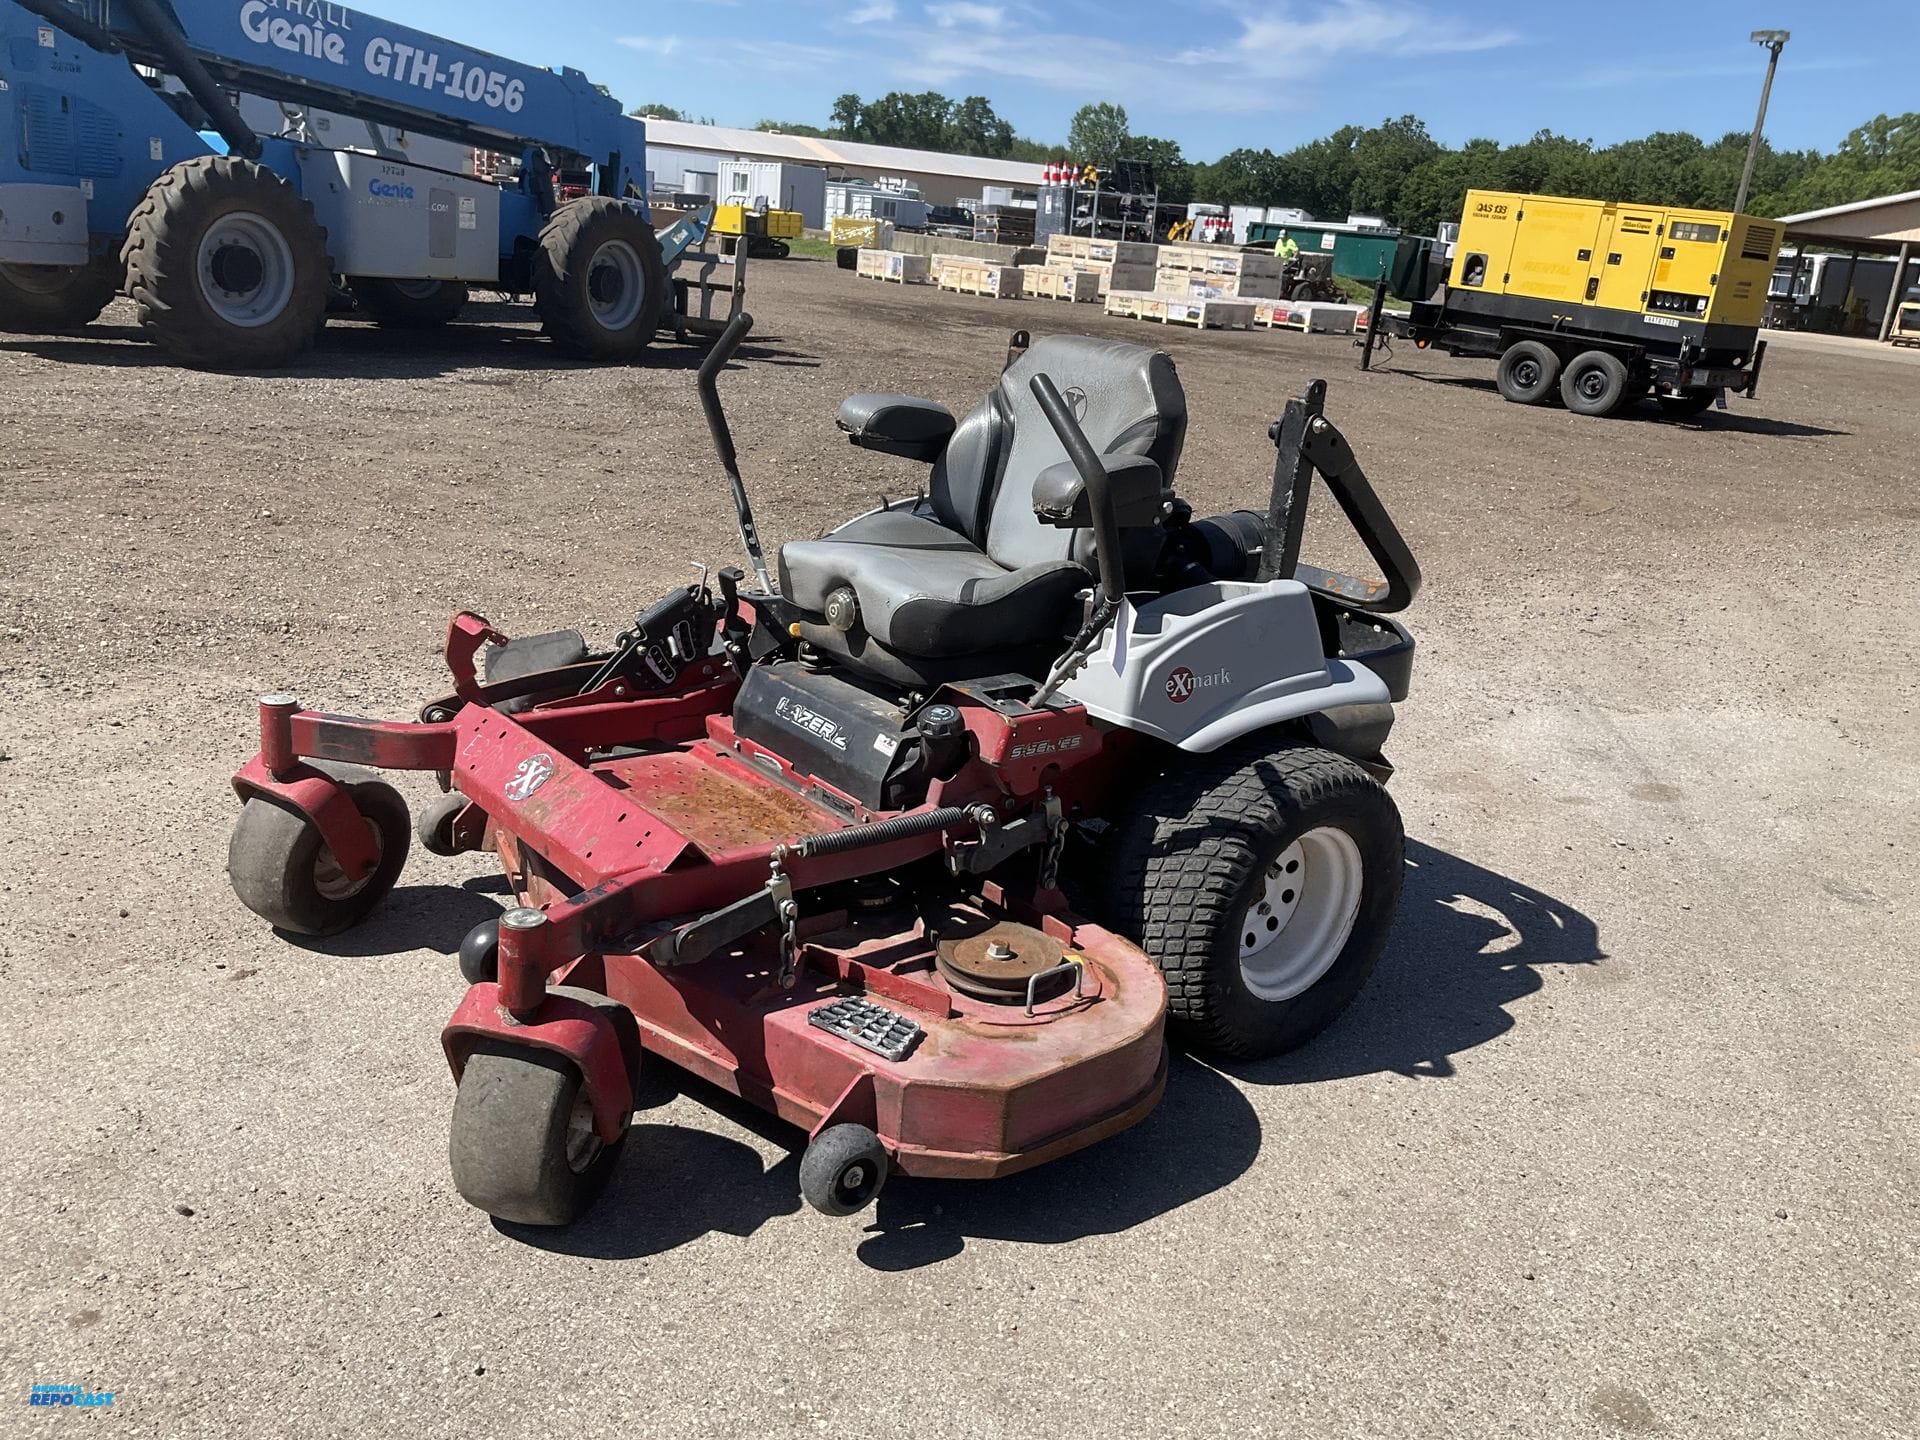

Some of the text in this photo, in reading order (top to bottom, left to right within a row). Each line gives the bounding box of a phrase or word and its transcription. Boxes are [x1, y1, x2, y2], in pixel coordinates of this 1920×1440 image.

[240, 1, 526, 114] Genie GTH-1056
[368, 178, 415, 199] Genie
[1165, 667, 1232, 699] eXmark
